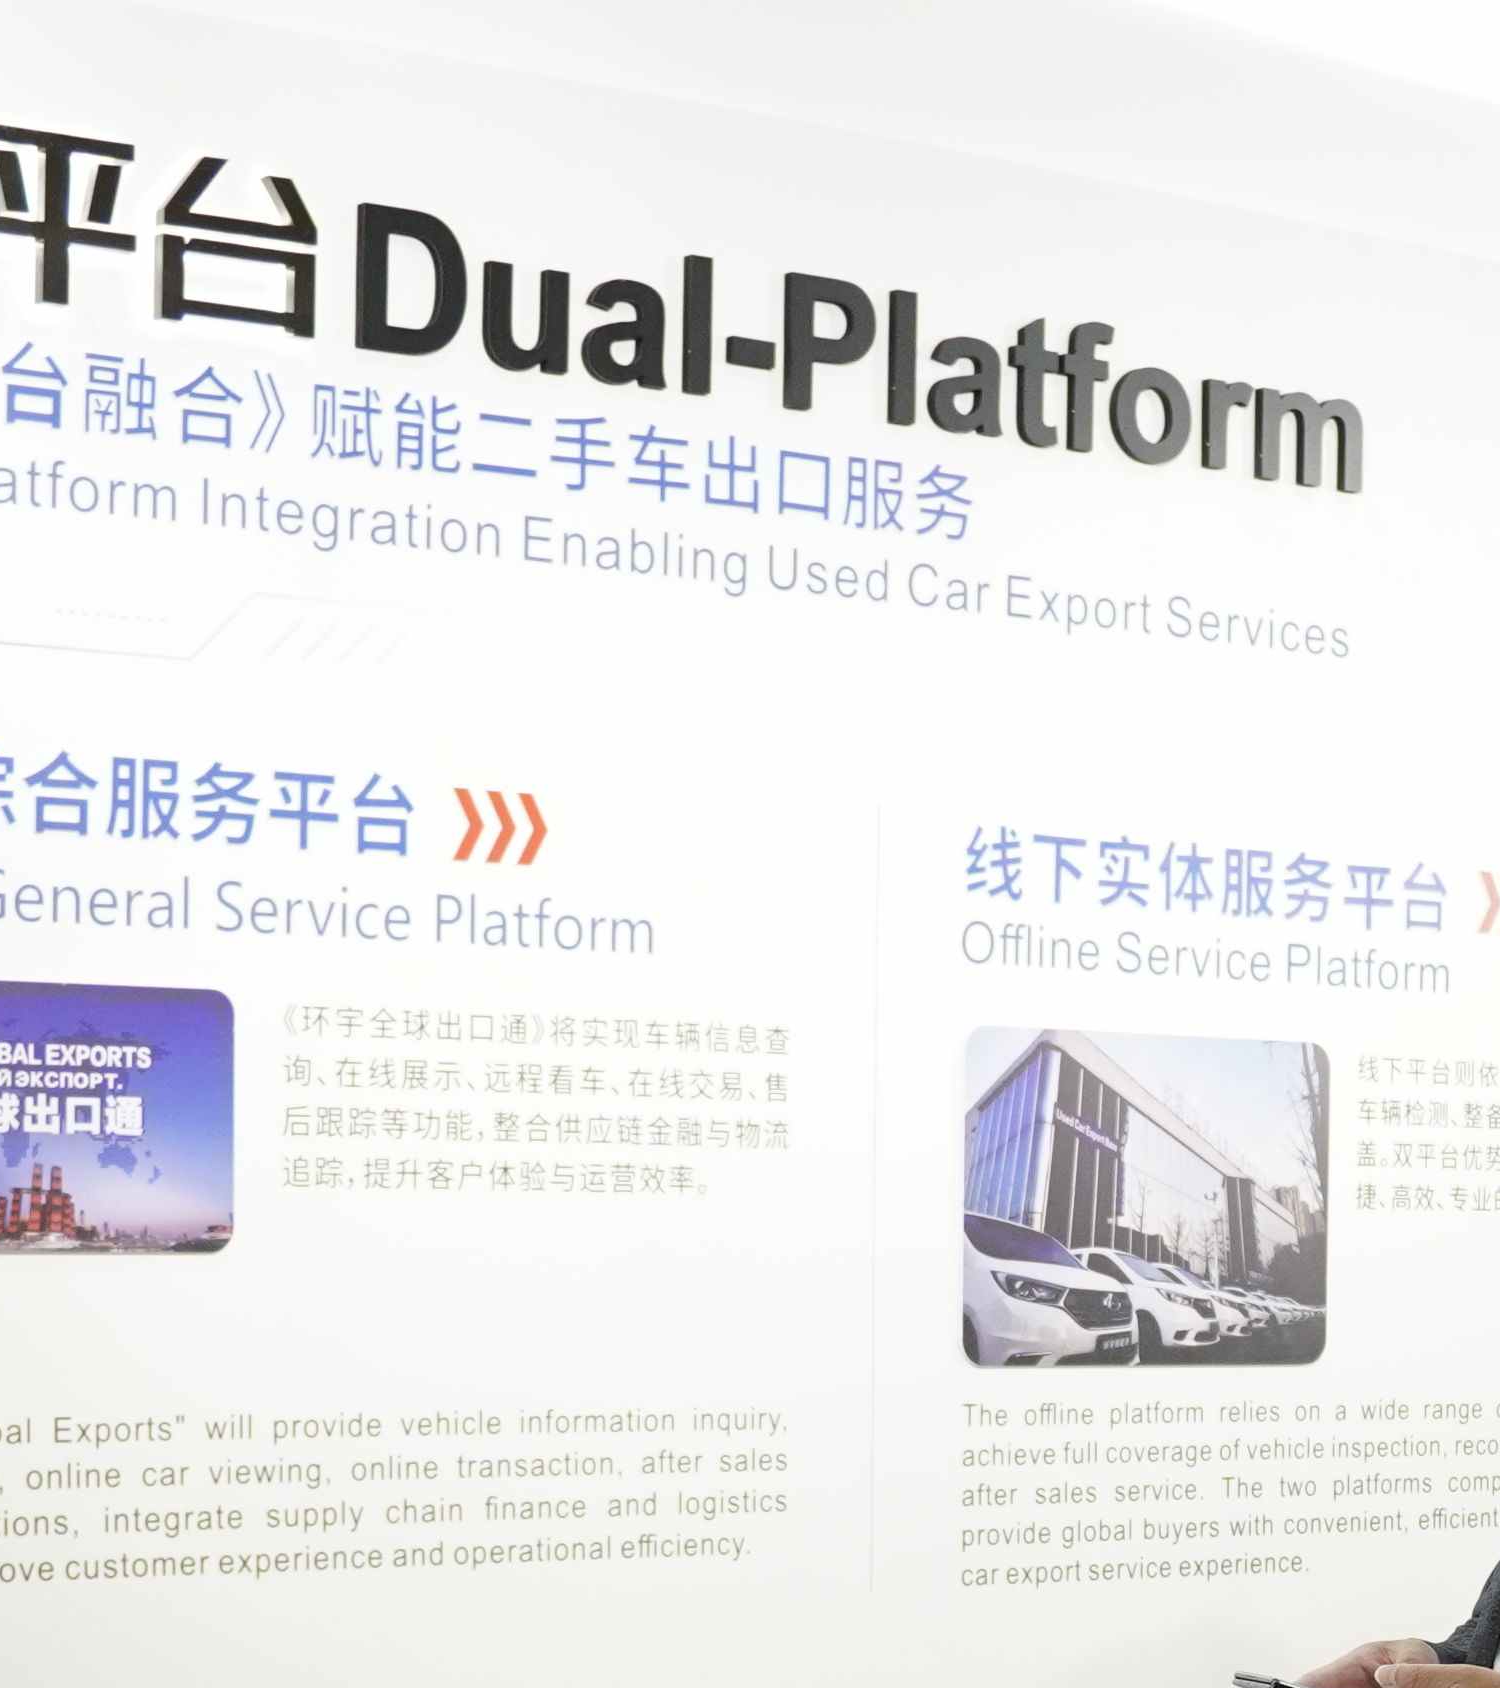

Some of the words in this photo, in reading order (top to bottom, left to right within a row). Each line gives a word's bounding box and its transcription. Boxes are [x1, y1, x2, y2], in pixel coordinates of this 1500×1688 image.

[353, 201, 1363, 495] Dual-Platform
[201, 476, 502, 559] Integration
[522, 513, 749, 599] Enabling
[767, 543, 890, 604] Used
[906, 561, 992, 615] Car
[1005, 573, 1152, 637] Export
[1165, 594, 1350, 660] Services
[964, 824, 1448, 933] 线下实体服务平台
[214, 879, 413, 943] Service
[435, 892, 654, 955] Platform
[960, 919, 1101, 973] Offline
[1115, 929, 1272, 984] Service
[1285, 942, 1451, 994] Platform
[45, 1044, 153, 1070] EXPORTS
[52, 1413, 187, 1451] Exports"
[203, 1412, 254, 1442] will
[271, 1411, 383, 1447] provide
[399, 1408, 503, 1438] vehicle
[519, 1407, 676, 1436] information
[692, 1406, 788, 1438] inquiry,
[960, 1401, 1010, 1429] The
[1022, 1400, 1096, 1428] offline
[1108, 1399, 1206, 1432] platform
[1218, 1398, 1282, 1425] relies
[1293, 1403, 1322, 1424] on
[1333, 1403, 1348, 1424] a
[1359, 1397, 1412, 1422] wide
[1422, 1401, 1485, 1426] range
[24, 1460, 123, 1492] online
[140, 1464, 192, 1489] car
[207, 1456, 332, 1491] viewing,
[349, 1454, 440, 1483] online
[455, 1450, 624, 1480] transaction,
[640, 1447, 705, 1476] after
[718, 1446, 789, 1474] sales
[960, 1442, 1058, 1469] achieve
[1061, 1439, 1099, 1466] full
[1104, 1443, 1214, 1470] coverage
[1218, 1436, 1242, 1463] of
[1245, 1435, 1326, 1462] vehicle
[1330, 1433, 1449, 1465] inspection,
[960, 1519, 1053, 1554] provide
[1060, 1517, 1134, 1551] global
[1141, 1516, 1222, 1547] buyers
[1227, 1512, 1275, 1538] with
[1282, 1508, 1410, 1537] convenient,
[1416, 1505, 1500, 1532] efficient
[63, 1551, 211, 1582] customer
[216, 1544, 384, 1582] experience
[391, 1539, 445, 1569] and
[452, 1534, 613, 1571] operational
[619, 1532, 752, 1563] efficiency.
[959, 1566, 1001, 1588] car
[1004, 1558, 1083, 1591] export
[1086, 1554, 1173, 1583] service
[1177, 1551, 1310, 1584] experience.
